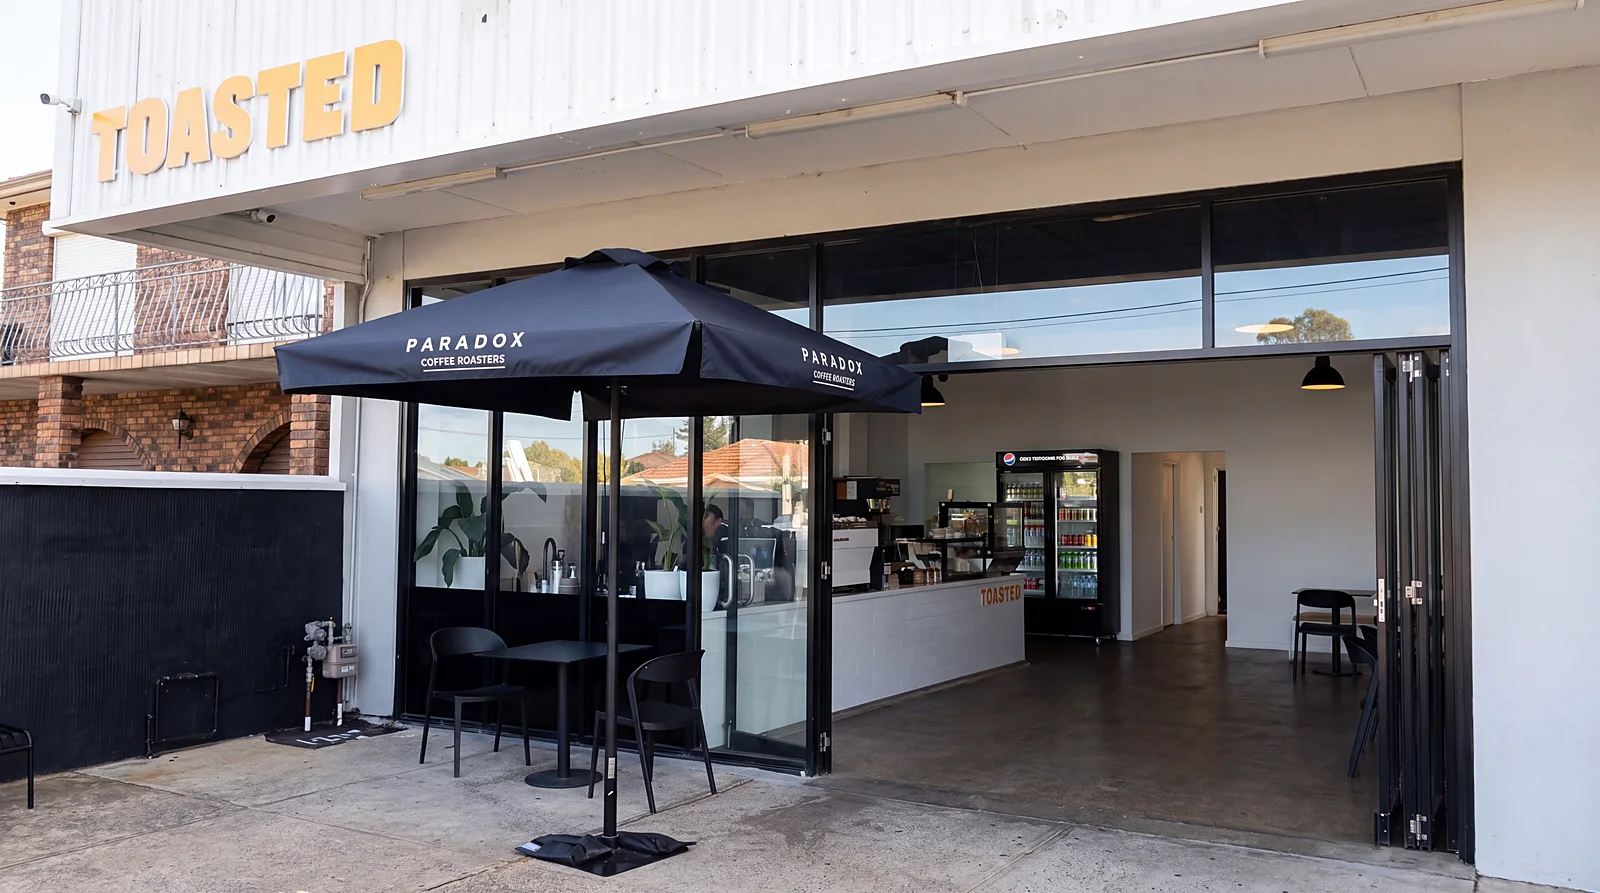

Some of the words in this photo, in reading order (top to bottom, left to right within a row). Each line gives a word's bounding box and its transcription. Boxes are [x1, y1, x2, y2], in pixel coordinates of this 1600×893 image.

[92, 39, 406, 183] TOASTED
[405, 331, 525, 353] PARADOX
[420, 356, 455, 367] COFFEE
[457, 354, 505, 365] ROASTERS
[801, 347, 863, 375] PARADOX
[813, 370, 832, 382] COFFEE
[832, 374, 856, 387] ROASTERS
[980, 584, 1021, 607] TOASTED
